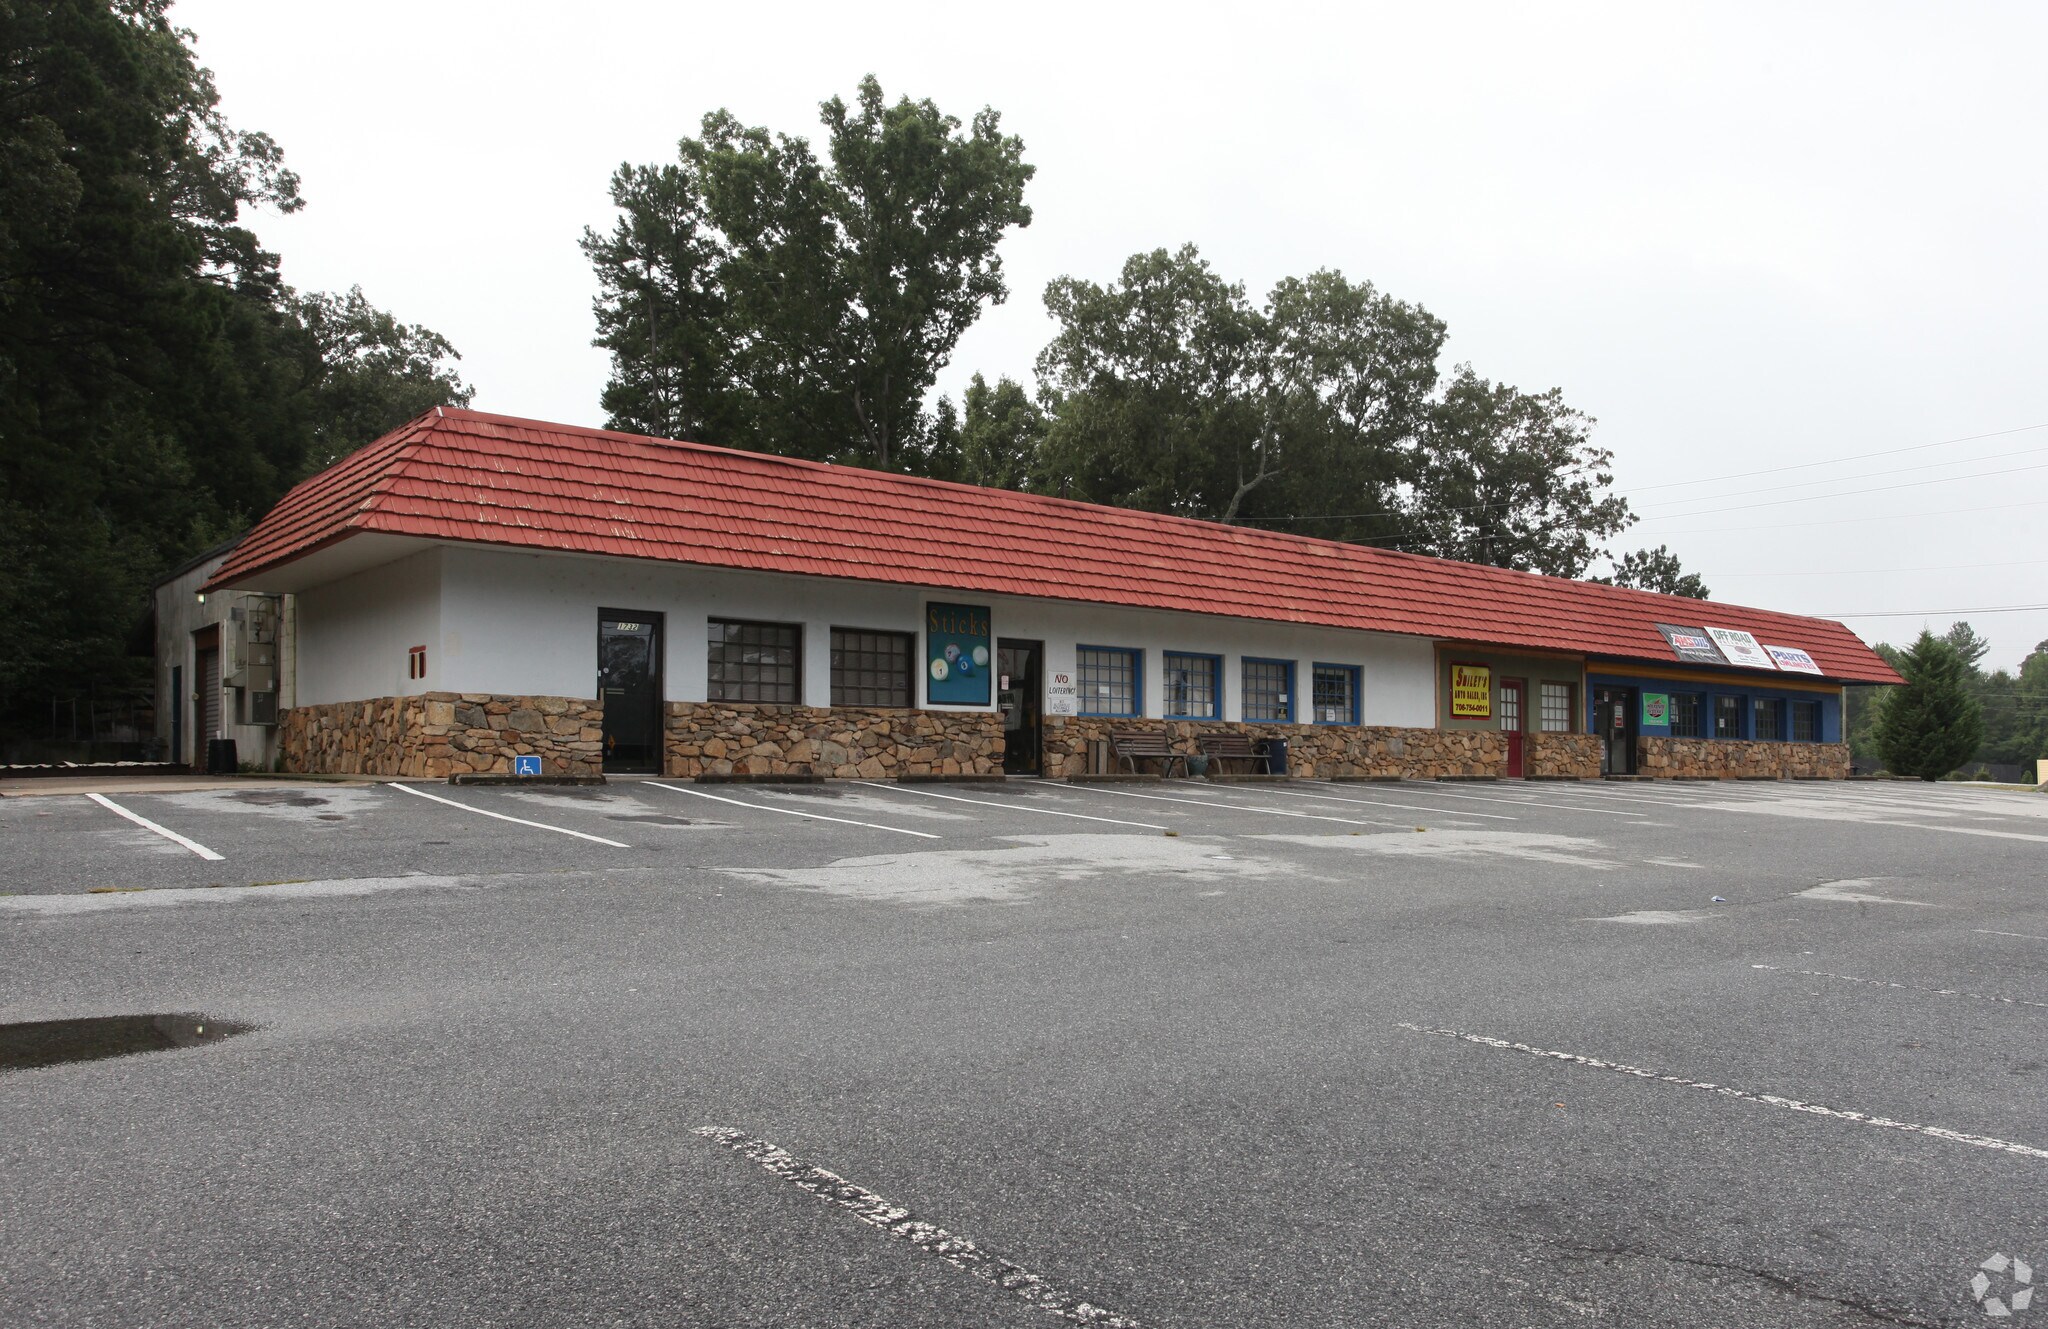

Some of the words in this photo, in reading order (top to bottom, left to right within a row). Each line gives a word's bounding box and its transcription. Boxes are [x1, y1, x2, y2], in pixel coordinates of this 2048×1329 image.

[617, 622, 640, 631] 1732
[930, 608, 988, 637] Sticks
[1673, 635, 1709, 648] AMSOIL
[1713, 630, 1729, 640] OFF
[1728, 632, 1752, 643] ROAD
[1771, 650, 1811, 664] PARTS
[1054, 674, 1069, 684] NO
